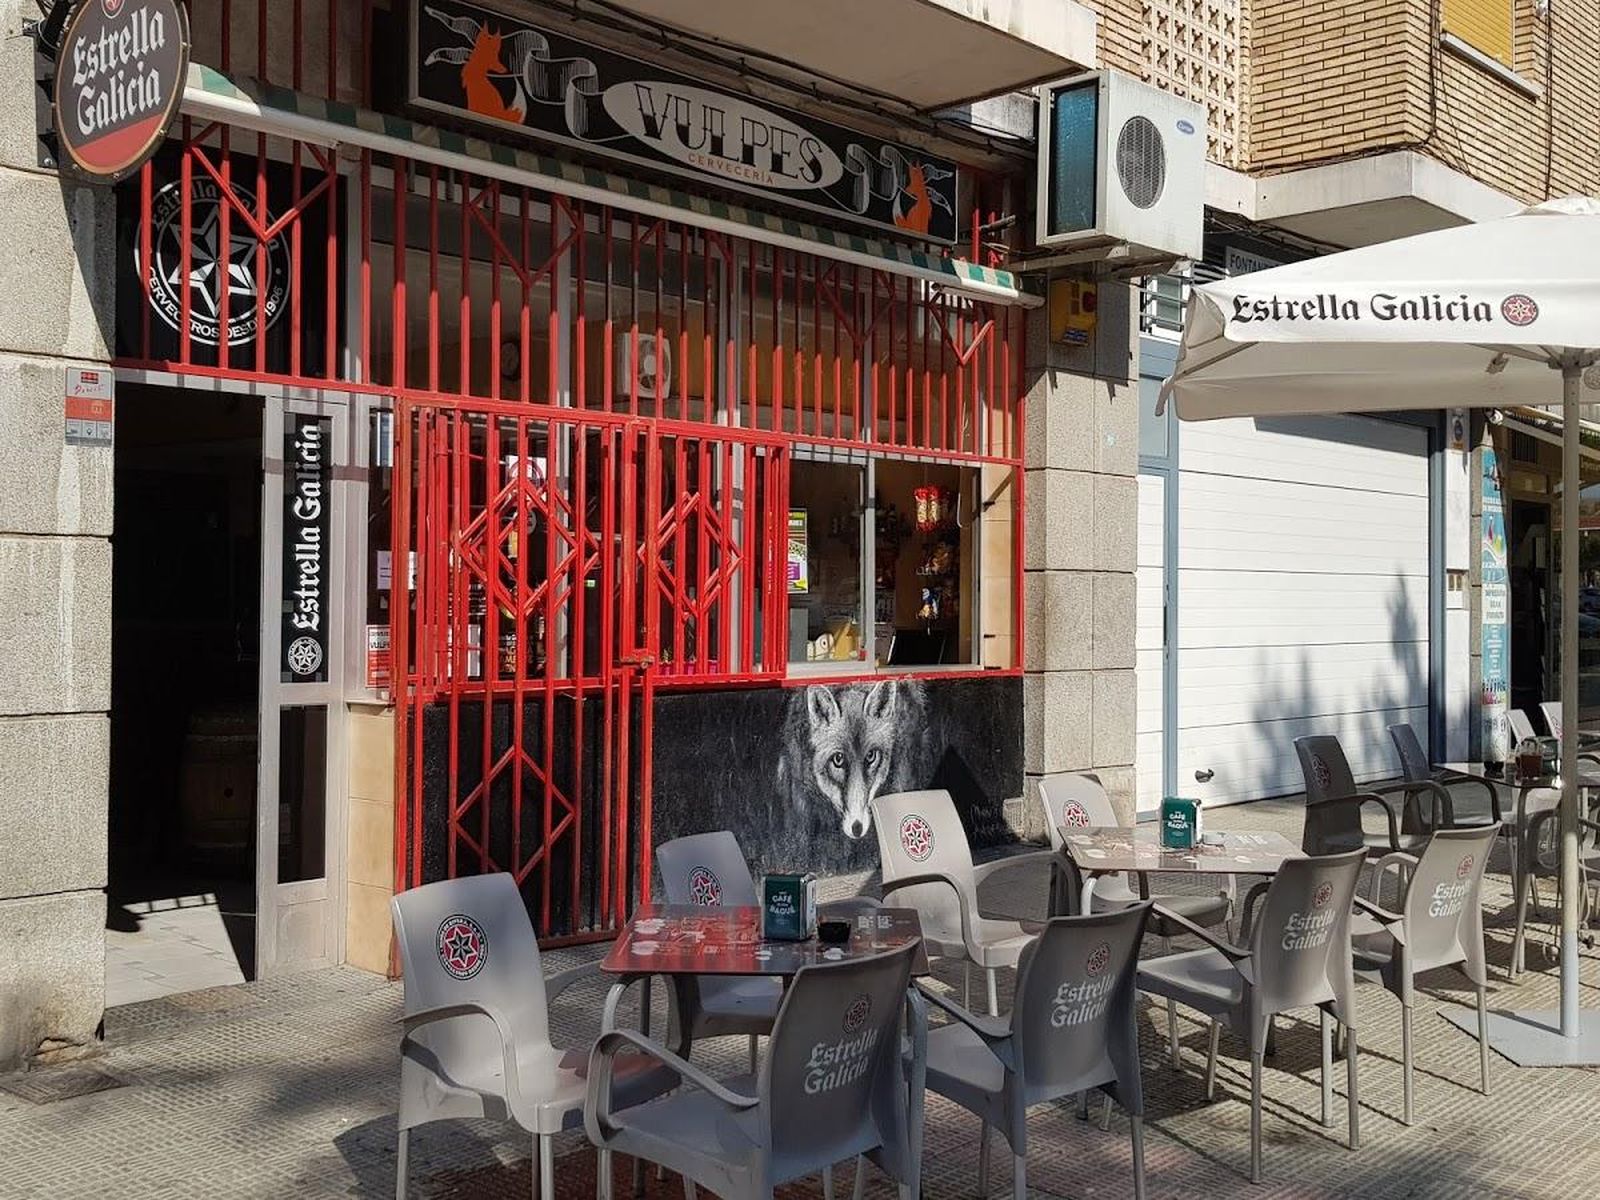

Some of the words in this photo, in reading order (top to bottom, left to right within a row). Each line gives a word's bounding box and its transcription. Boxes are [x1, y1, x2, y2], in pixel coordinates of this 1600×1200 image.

[72, 6, 165, 88] Estrella
[77, 61, 161, 135] Galicia
[634, 83, 823, 183] VULPES
[687, 152, 775, 185] CERVECERÍA
[1230, 293, 1359, 323] Estrella
[1370, 293, 1493, 323] Galicia
[293, 424, 322, 520] Galicia
[293, 525, 321, 632] Estrella
